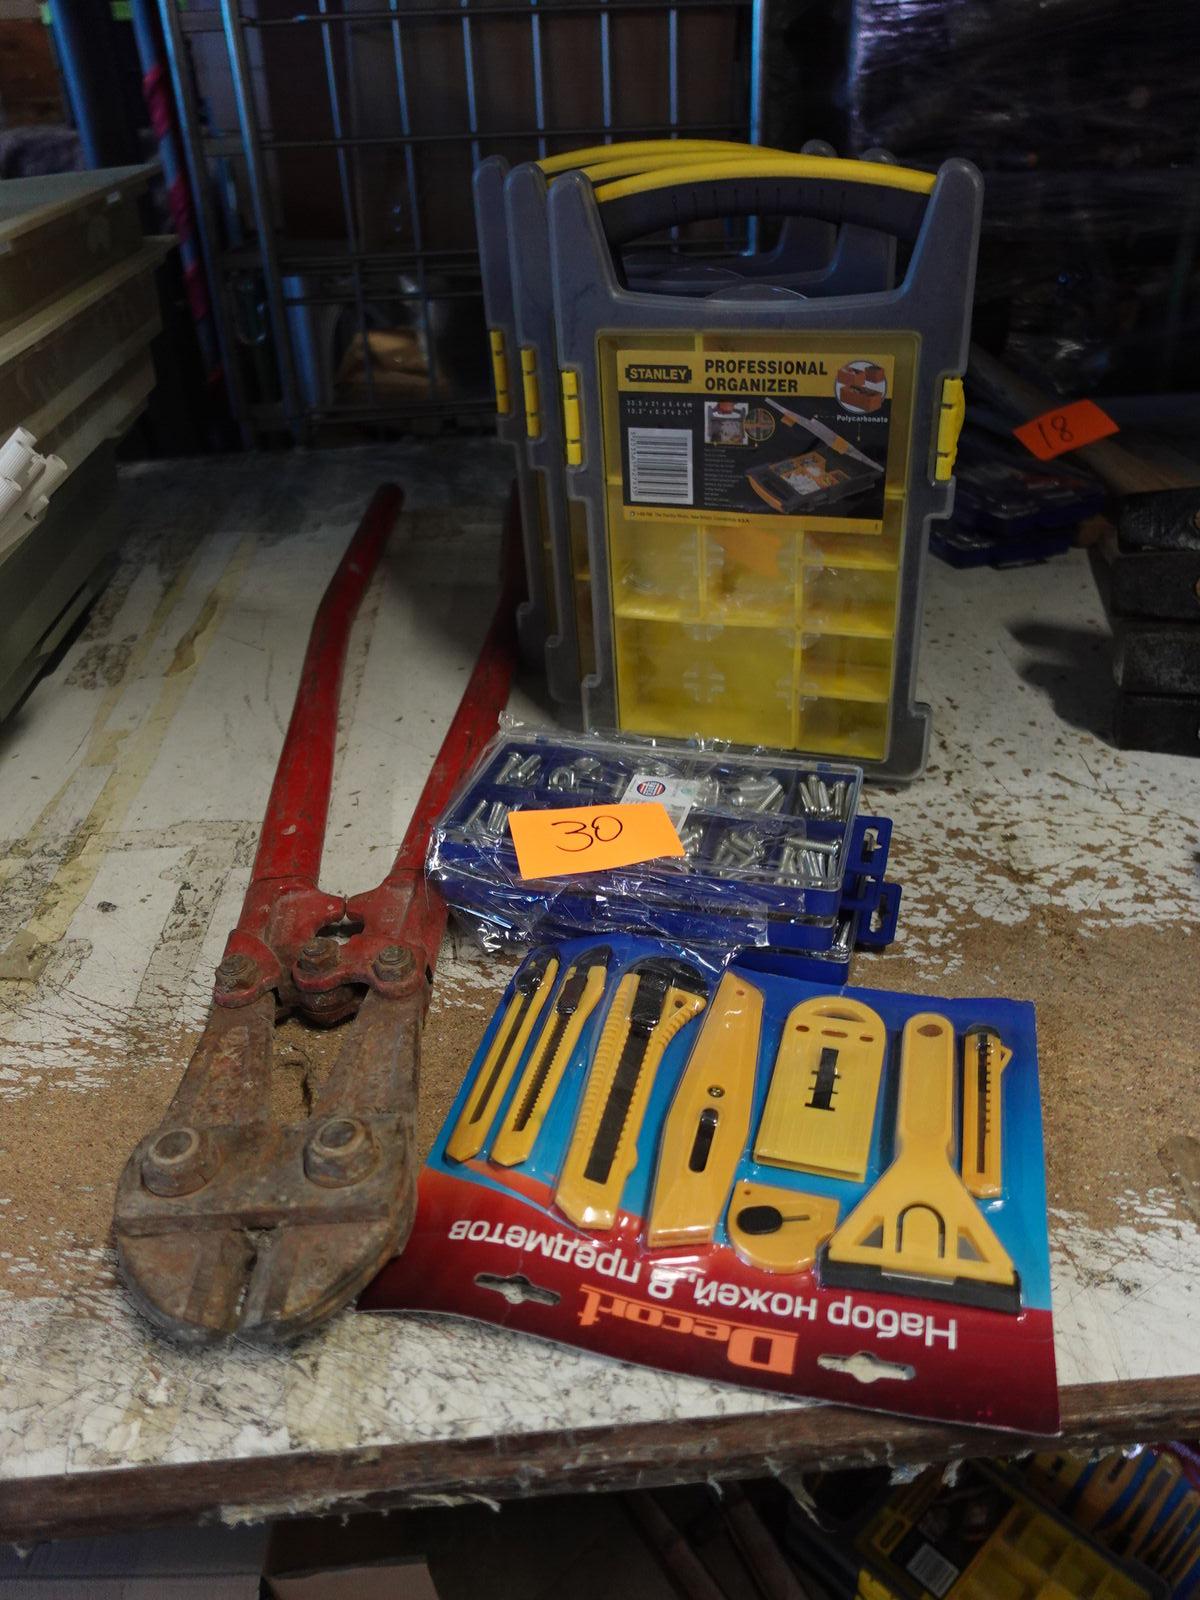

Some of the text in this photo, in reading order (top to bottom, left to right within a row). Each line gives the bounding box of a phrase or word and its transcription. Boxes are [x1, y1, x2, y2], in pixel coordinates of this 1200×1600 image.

[629, 367, 688, 381] STANLEY
[704, 358, 828, 376] PROFESSIONAL
[704, 377, 798, 394] ORGANIZER
[1038, 415, 1074, 450] 18
[551, 815, 623, 852] 30
[448, 1220, 957, 1350] Набор ножей, 8 предметов
[577, 1285, 799, 1376] Decort
